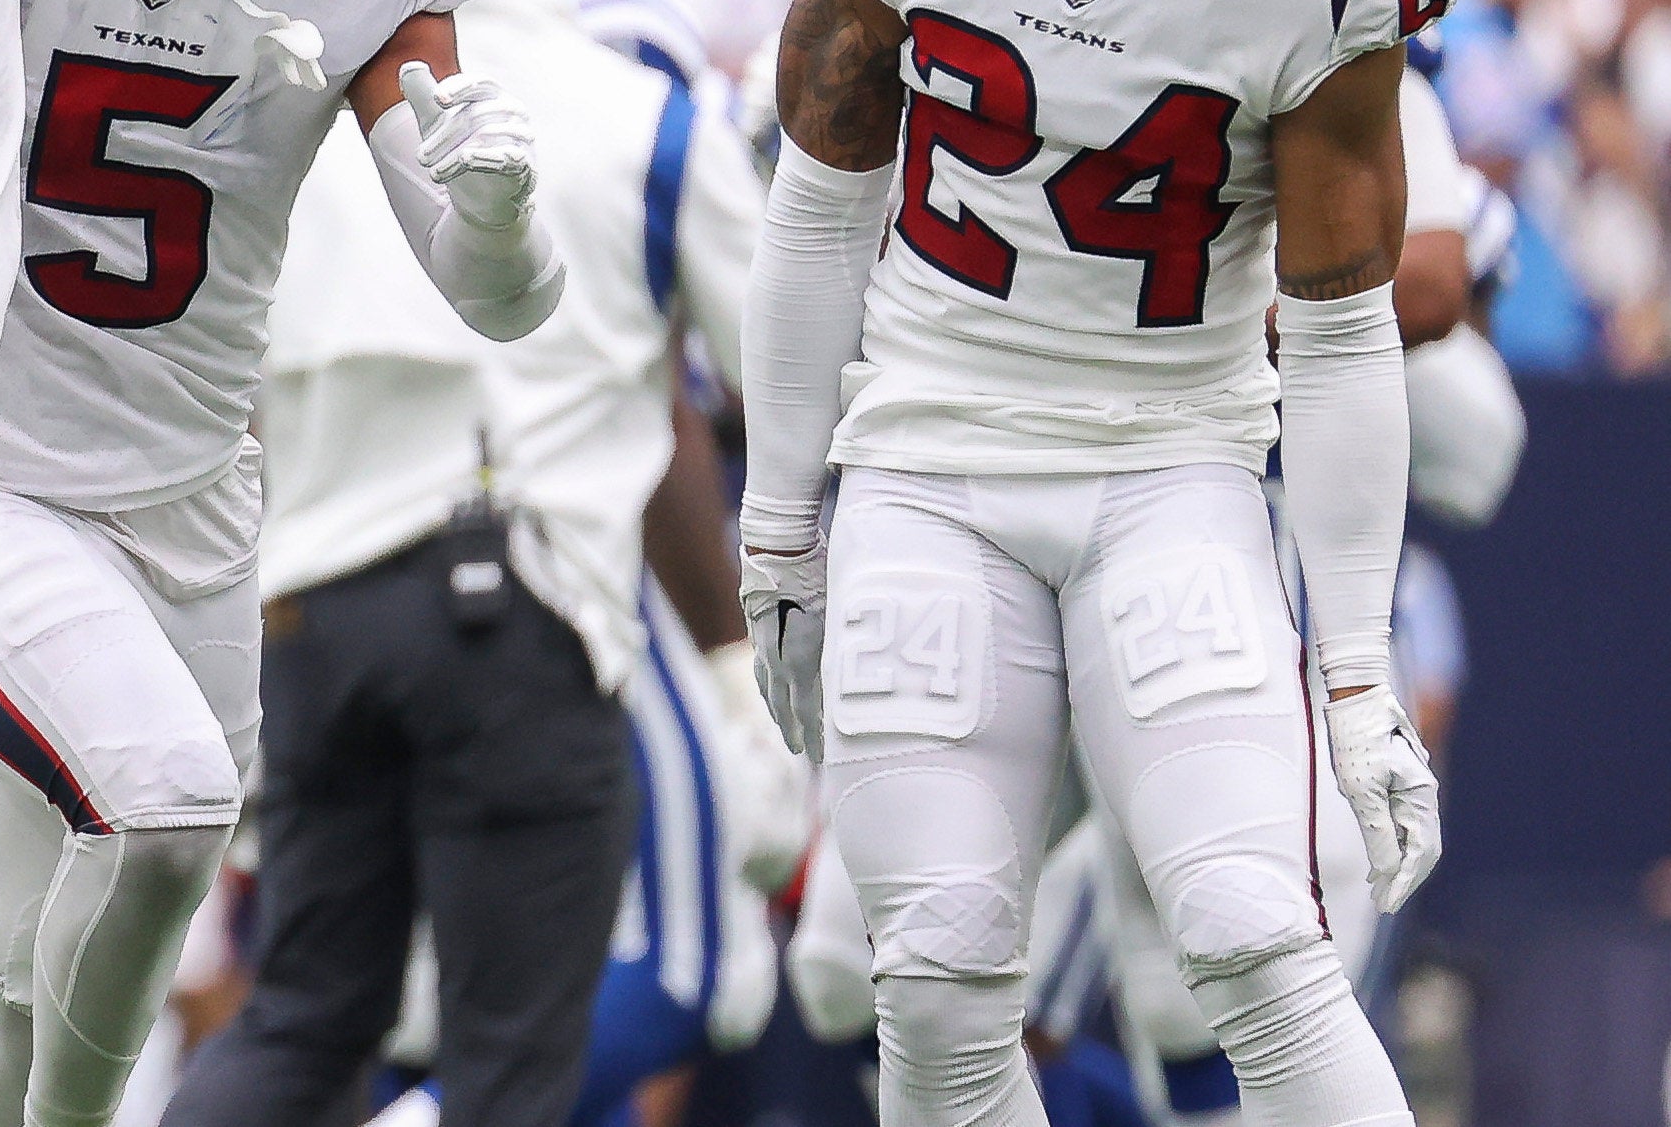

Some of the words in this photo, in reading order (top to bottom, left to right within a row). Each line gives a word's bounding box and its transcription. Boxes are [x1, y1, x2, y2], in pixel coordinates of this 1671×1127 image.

[94, 25, 206, 57] TEXANS
[1013, 10, 1126, 53] TEXANS
[24, 48, 240, 330] 5
[895, 8, 1244, 329] 24
[840, 594, 961, 700] 24
[1113, 562, 1243, 689] 24
